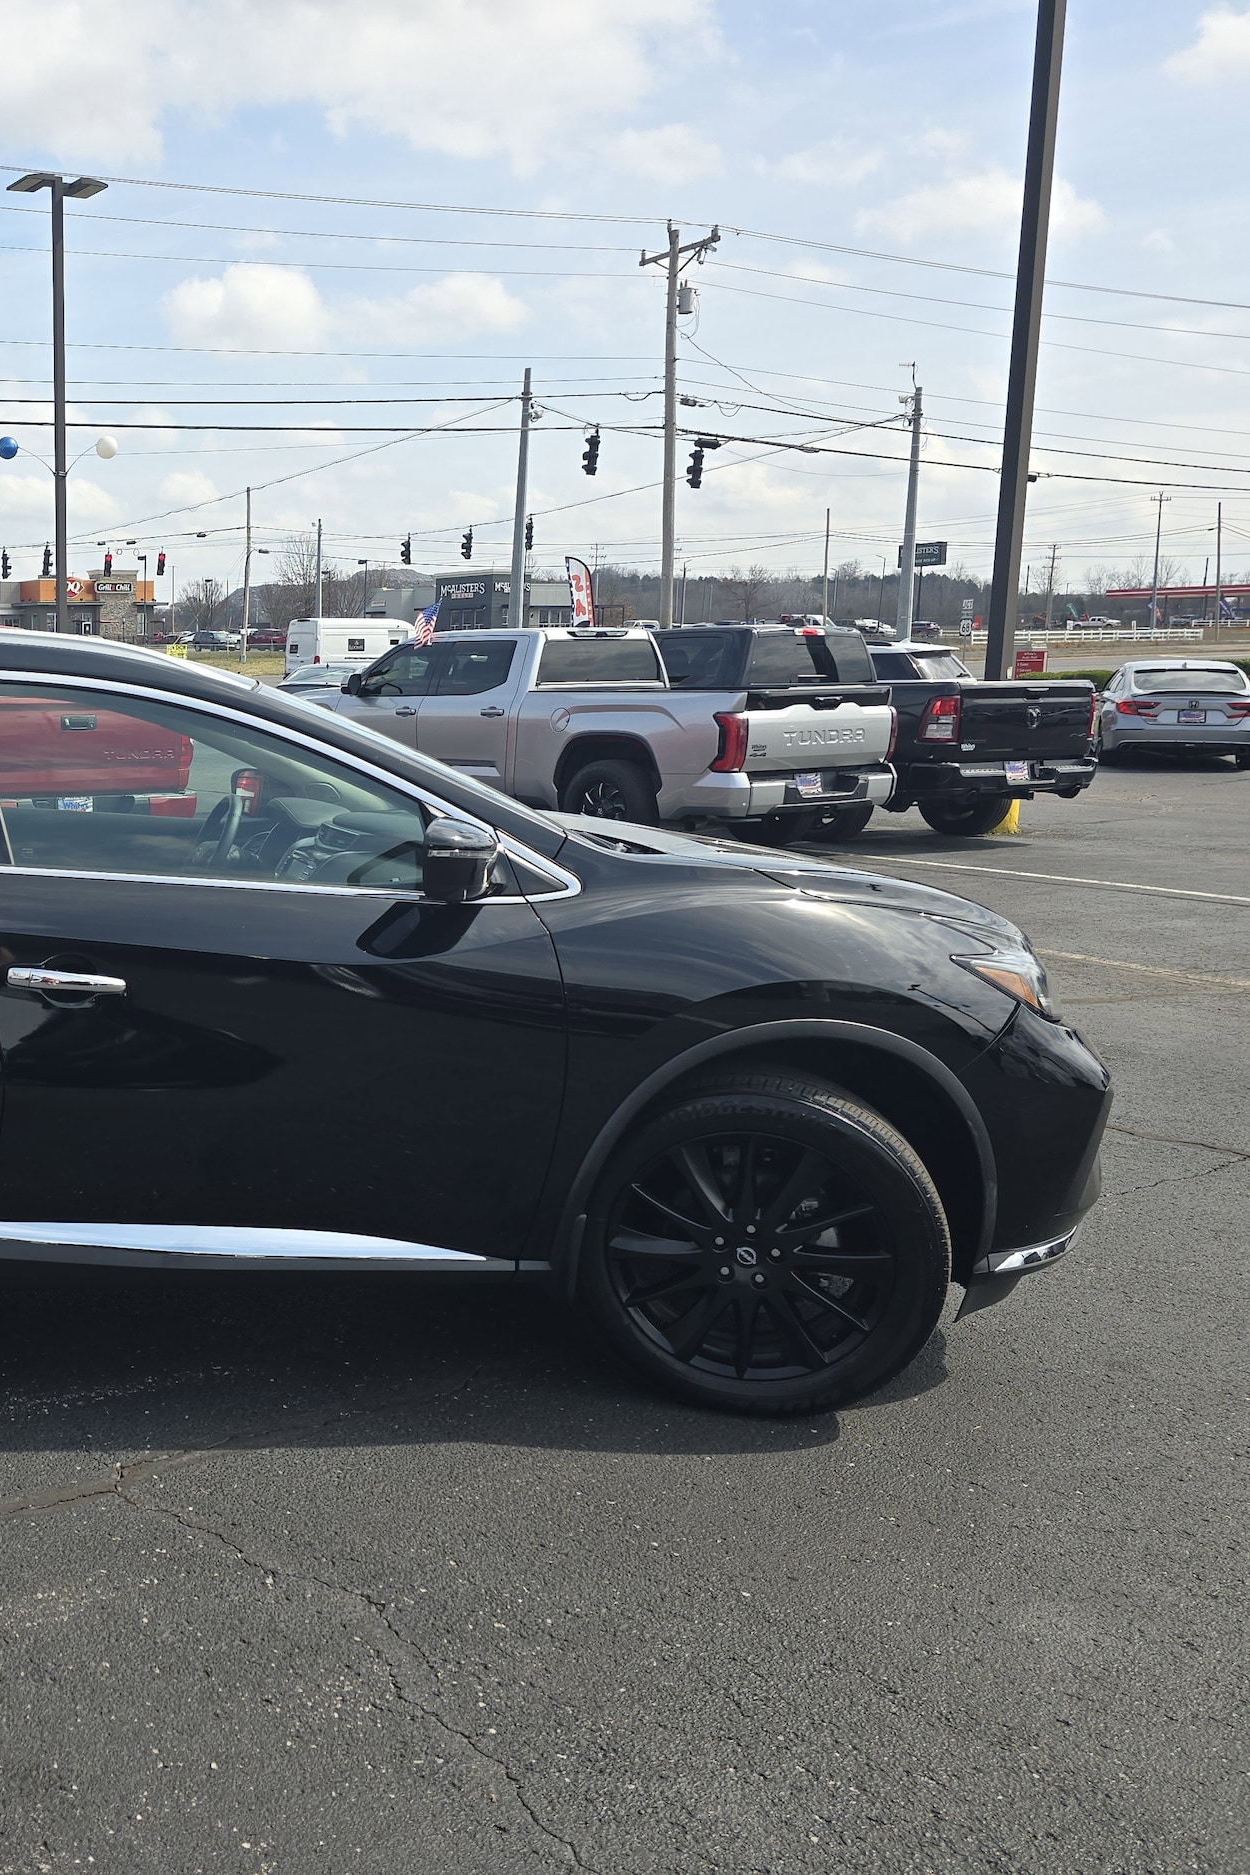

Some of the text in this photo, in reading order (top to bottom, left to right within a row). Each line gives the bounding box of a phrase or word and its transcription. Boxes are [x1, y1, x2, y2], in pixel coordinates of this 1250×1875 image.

[98, 583, 111, 591] Grill
[116, 582, 130, 591] Chill
[783, 728, 865, 746] TUNDRA
[103, 748, 175, 760] TUNDRA
